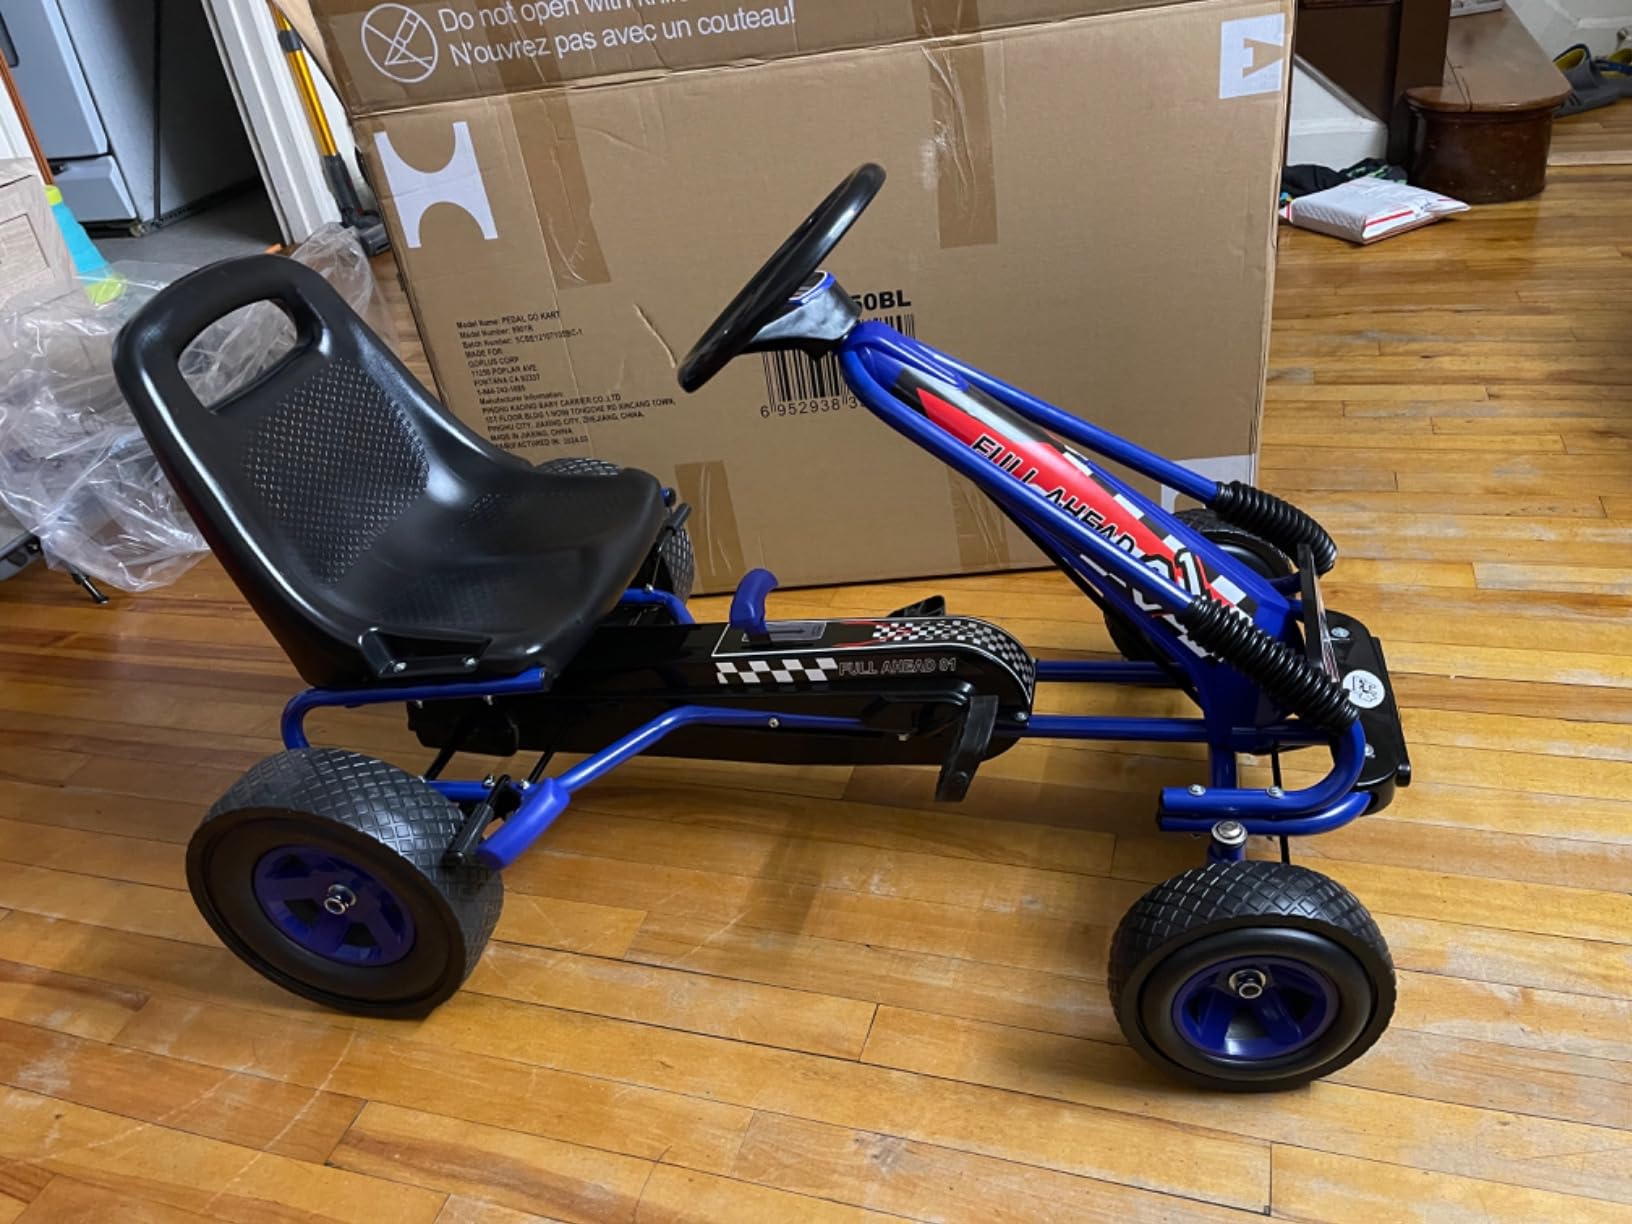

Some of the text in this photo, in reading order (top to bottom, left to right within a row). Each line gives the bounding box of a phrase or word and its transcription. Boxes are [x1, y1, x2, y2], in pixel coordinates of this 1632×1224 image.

[438, 8, 474, 32] Do
[480, 2, 517, 26] not
[520, 0, 580, 26] open
[449, 0, 796, 66] N'ouvrez pas avec un couteau!
[502, 314, 526, 323] PEDAL
[541, 310, 560, 319] KART
[465, 350, 487, 358] MADE
[492, 365, 521, 375] POPLAR
[474, 377, 507, 387] FONTANA
[560, 396, 591, 407] CARRIER
[760, 405, 770, 418] 6
[778, 400, 840, 416] 952938
[499, 412, 522, 422] FLOOR
[490, 432, 511, 441] MADE
[839, 660, 878, 676] FULL
[880, 658, 936, 674] AHEAD
